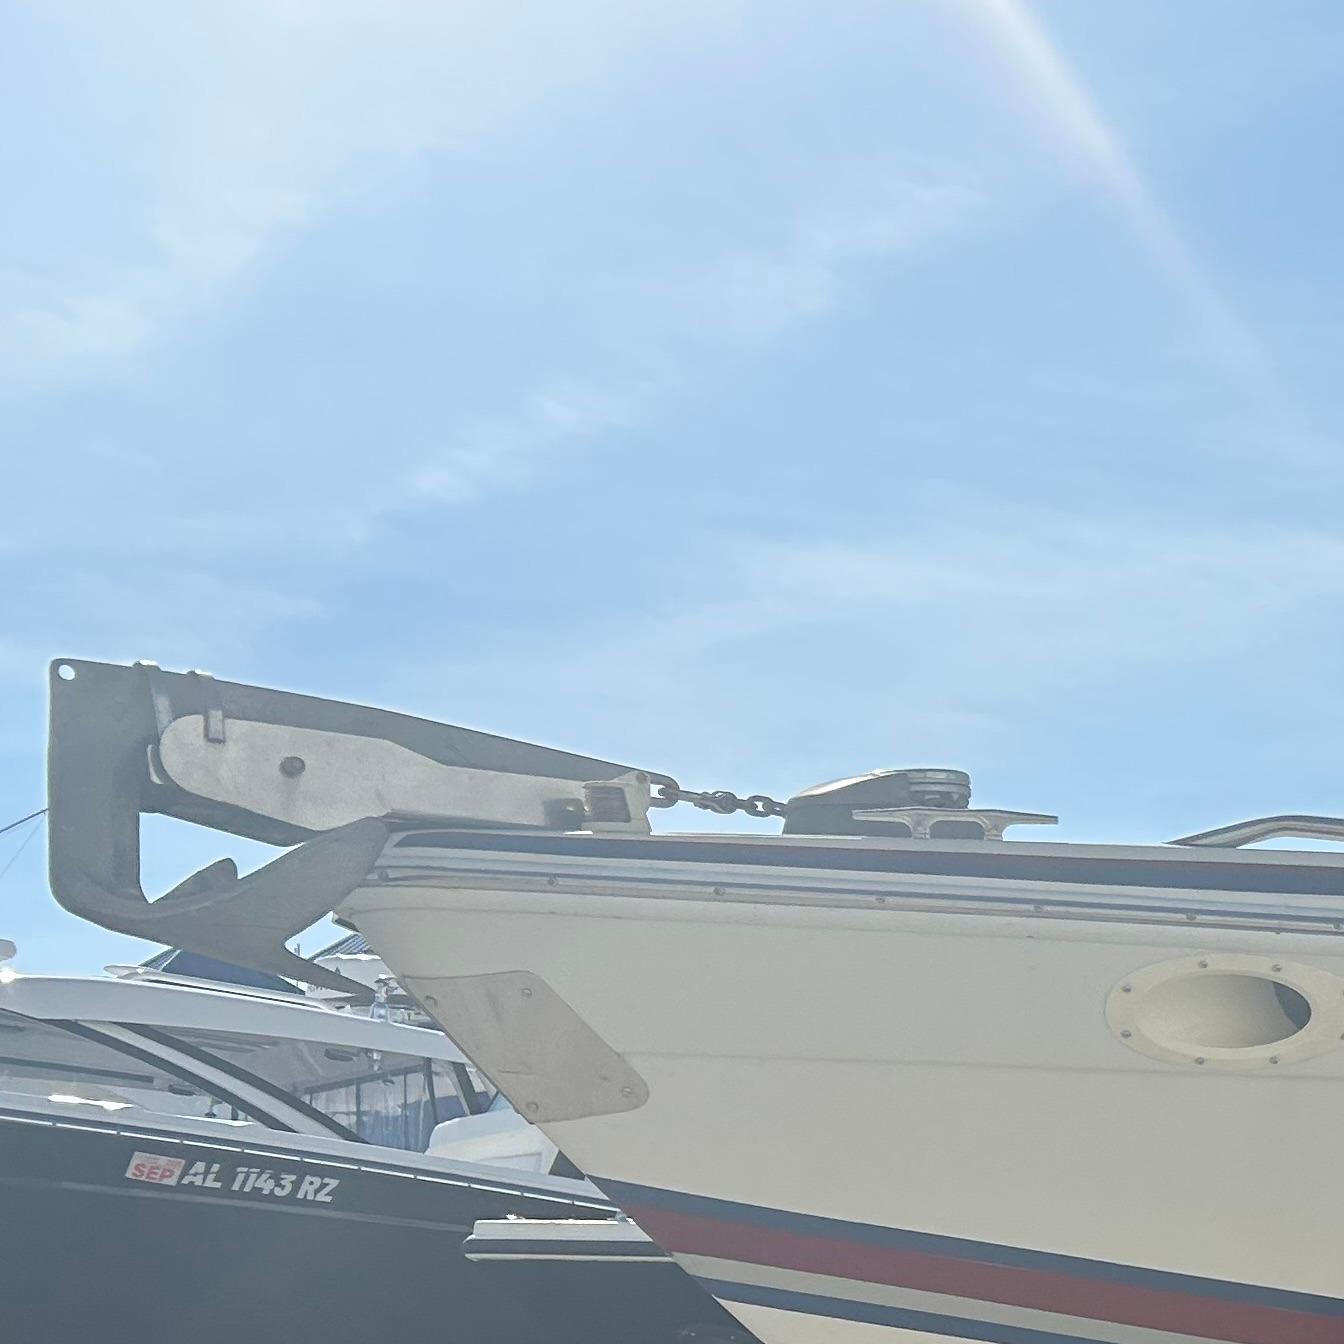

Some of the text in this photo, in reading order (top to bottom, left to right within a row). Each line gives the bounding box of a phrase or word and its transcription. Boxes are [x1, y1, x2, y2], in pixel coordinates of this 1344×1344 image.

[132, 1162, 176, 1181] SEP
[181, 1161, 341, 1203] AL 1143 RZ
